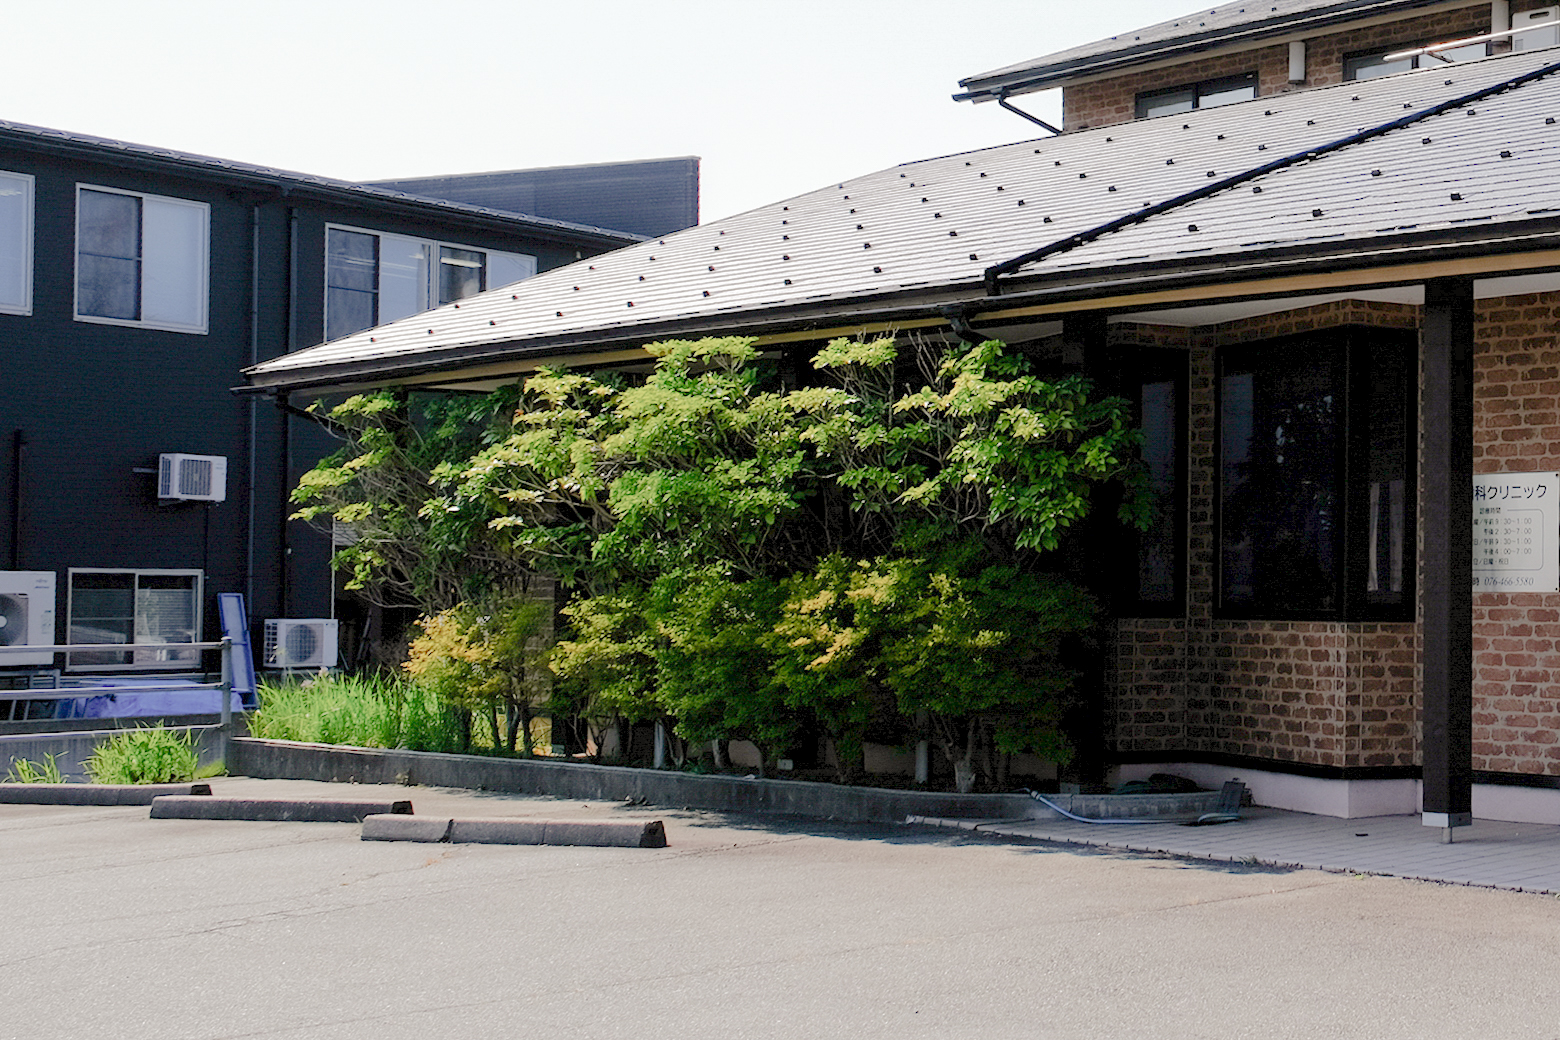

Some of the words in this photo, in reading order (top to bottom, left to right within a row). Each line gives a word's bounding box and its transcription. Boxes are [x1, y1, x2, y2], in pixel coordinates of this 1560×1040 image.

[1474, 484, 1547, 501] 科クリニック
